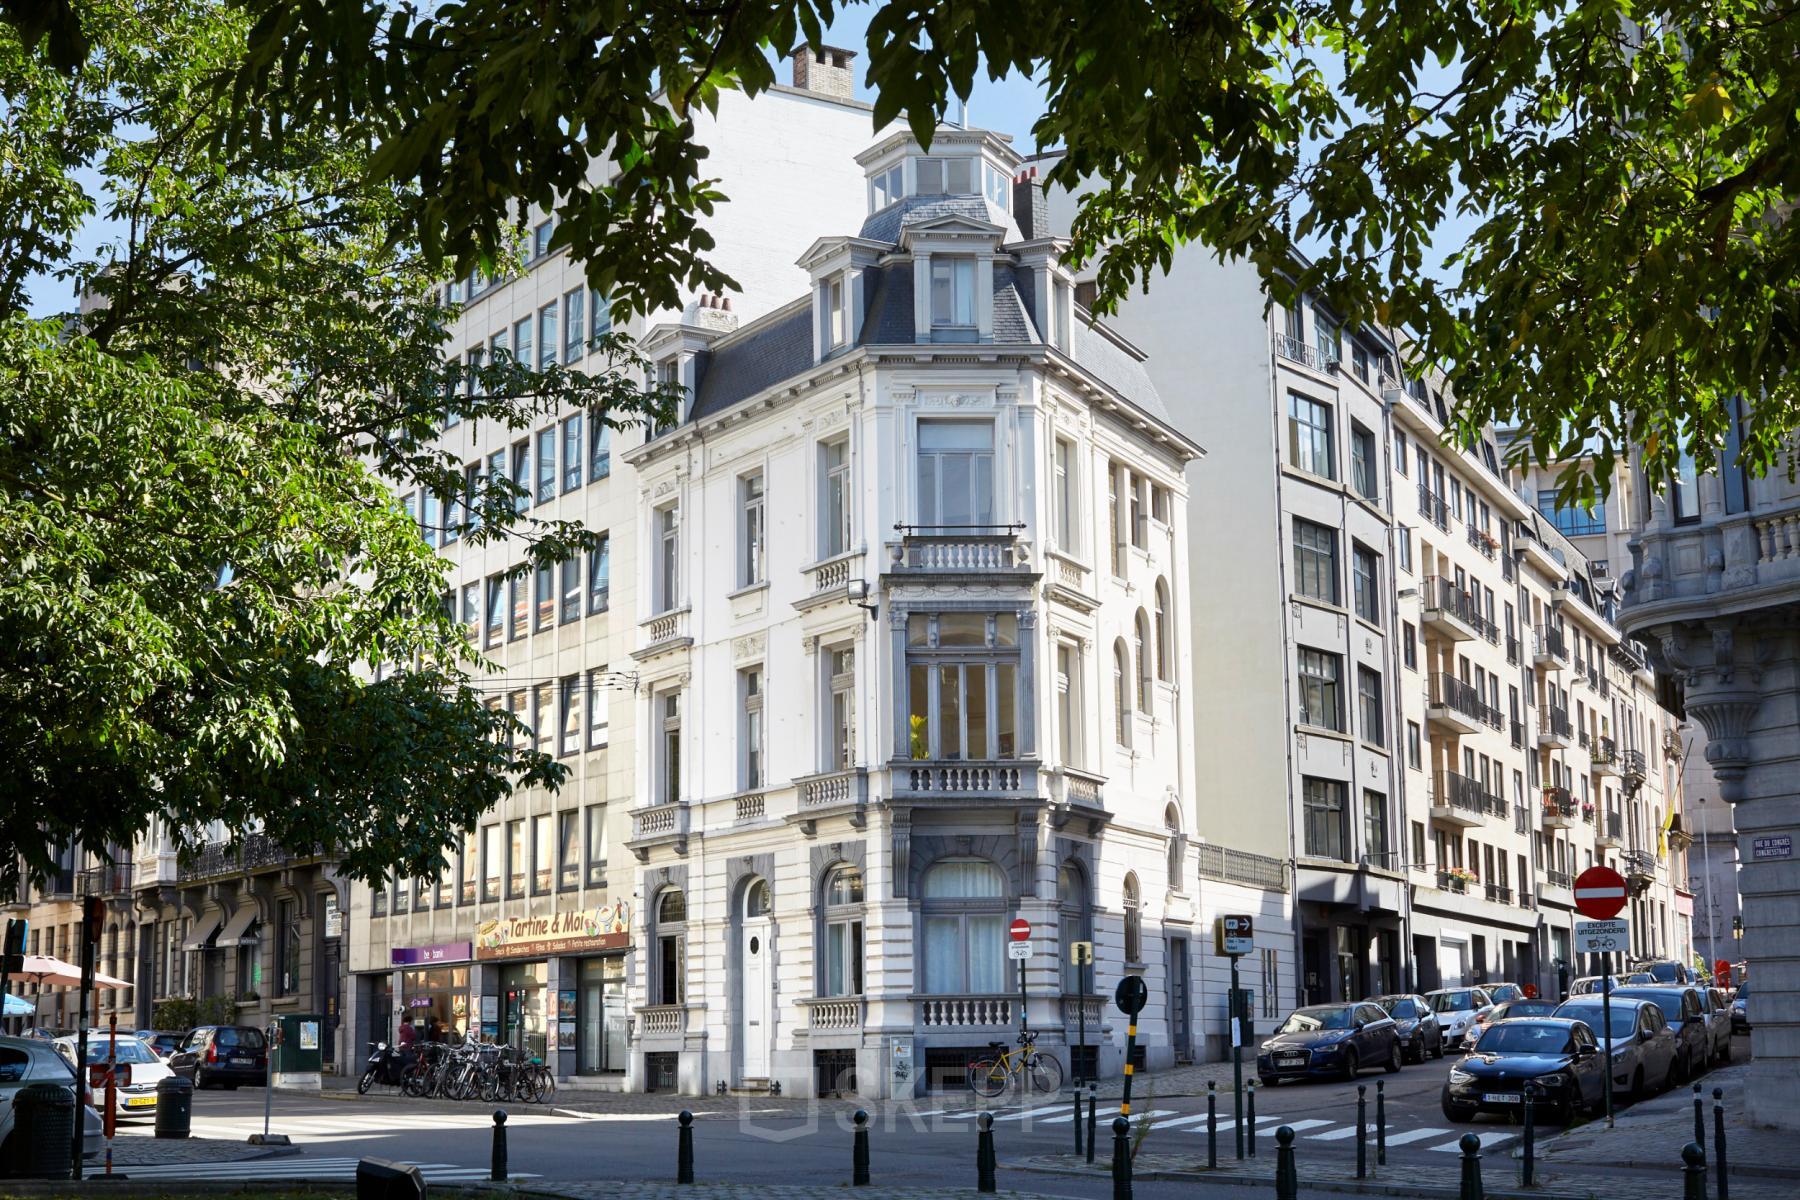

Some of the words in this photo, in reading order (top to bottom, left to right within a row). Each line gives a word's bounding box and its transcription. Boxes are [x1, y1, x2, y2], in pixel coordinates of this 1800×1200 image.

[1755, 839, 1763, 848] RUE
[1764, 839, 1770, 847] DU
[1755, 847, 1790, 857] CONGRESSTRAAT
[509, 916, 548, 938] Tartine
[551, 912, 561, 934] &
[564, 910, 585, 932] Moi
[1587, 921, 1616, 929] EXCEPTE
[1577, 927, 1626, 936] UITGEZONDERD
